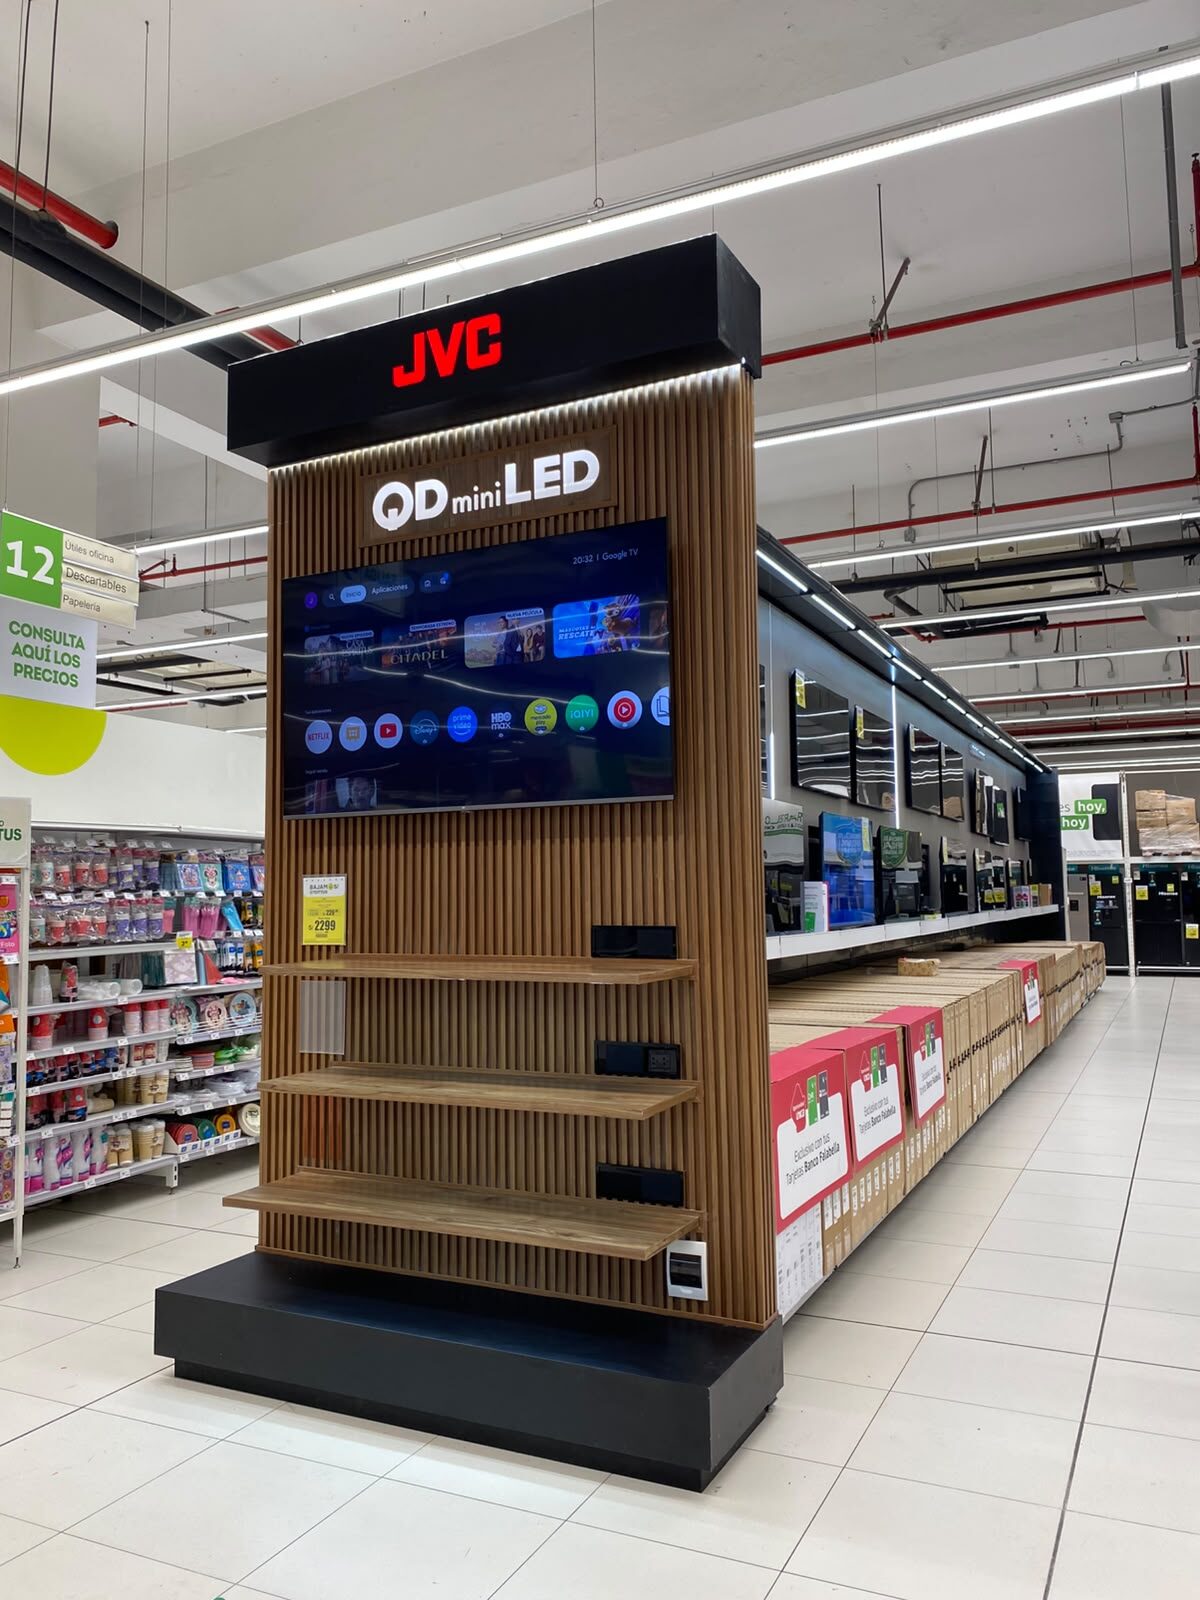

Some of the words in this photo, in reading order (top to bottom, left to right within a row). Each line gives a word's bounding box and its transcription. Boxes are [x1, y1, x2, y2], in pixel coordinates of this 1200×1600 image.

[392, 312, 501, 388] JVC
[372, 478, 449, 531] QD
[452, 481, 501, 515] mini
[504, 449, 600, 505] LED
[64, 539, 88, 556] Útiles
[89, 549, 115, 564] oficina
[572, 554, 593, 565] 20:32
[602, 550, 628, 562] Google
[629, 548, 639, 557] TV
[6, 540, 55, 586] 12
[66, 567, 127, 594] Descartables
[371, 583, 408, 595] Aplicaciones
[63, 594, 101, 612] Papelería
[8, 620, 86, 650] CONSULTA
[558, 630, 595, 640] RESCATE
[11, 641, 50, 663] AQUÍ
[54, 652, 81, 669] LOS
[390, 650, 448, 665] CITADEL
[13, 662, 79, 688] PRECIOS
[453, 714, 472, 722] prime
[491, 712, 512, 722] HBO
[491, 722, 512, 730] max
[307, 731, 330, 741] NETFLIX
[1077, 801, 1105, 814] hoy,
[1062, 816, 1087, 829] hoy
[314, 919, 336, 931] 2299
[871, 1114, 881, 1127] Banco
[881, 1105, 896, 1119] Falabella
[794, 1141, 814, 1163] Exclusivo
[814, 1137, 822, 1150] con
[786, 1164, 804, 1186] Tarjetas
[804, 1155, 819, 1173] Banco
[819, 1142, 840, 1161] Falabella
